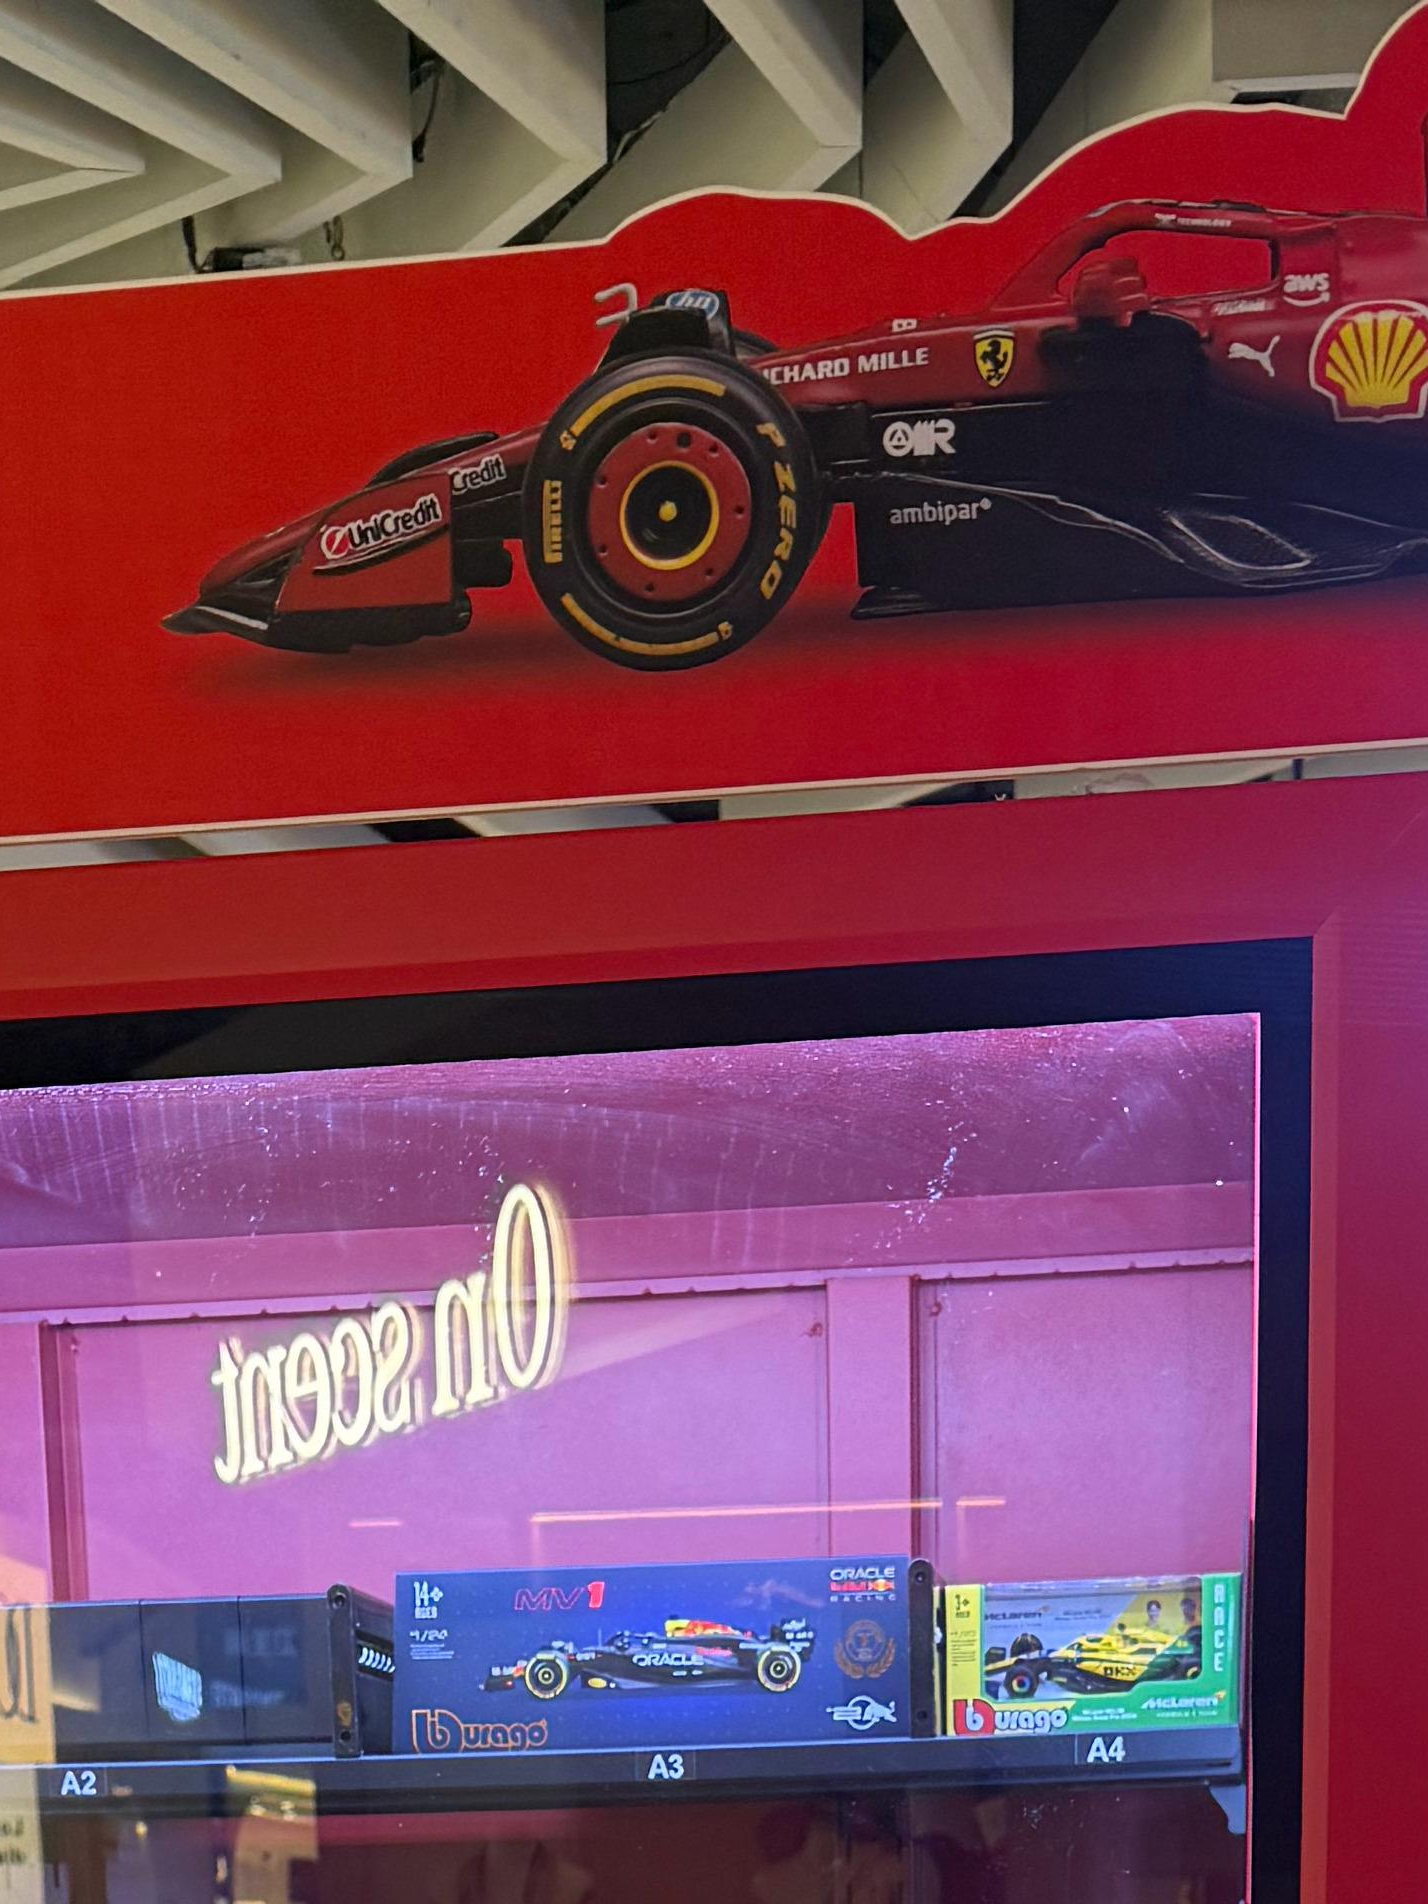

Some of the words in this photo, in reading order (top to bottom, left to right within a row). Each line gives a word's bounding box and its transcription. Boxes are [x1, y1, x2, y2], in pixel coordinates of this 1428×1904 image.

[1283, 273, 1329, 294] aws
[858, 346, 930, 372] MILLE
[347, 494, 443, 551] UniCredit
[889, 497, 980, 526] ambipar
[761, 460, 801, 601] ZERO
[830, 1567, 896, 1581] ORACLE
[514, 1581, 606, 1611] MV1
[632, 1653, 704, 1667] ORACLE
[953, 1699, 1069, 1736] burago
[1087, 1736, 1125, 1763] A4
[648, 1754, 685, 1780] A3
[60, 1771, 97, 1796] A2
